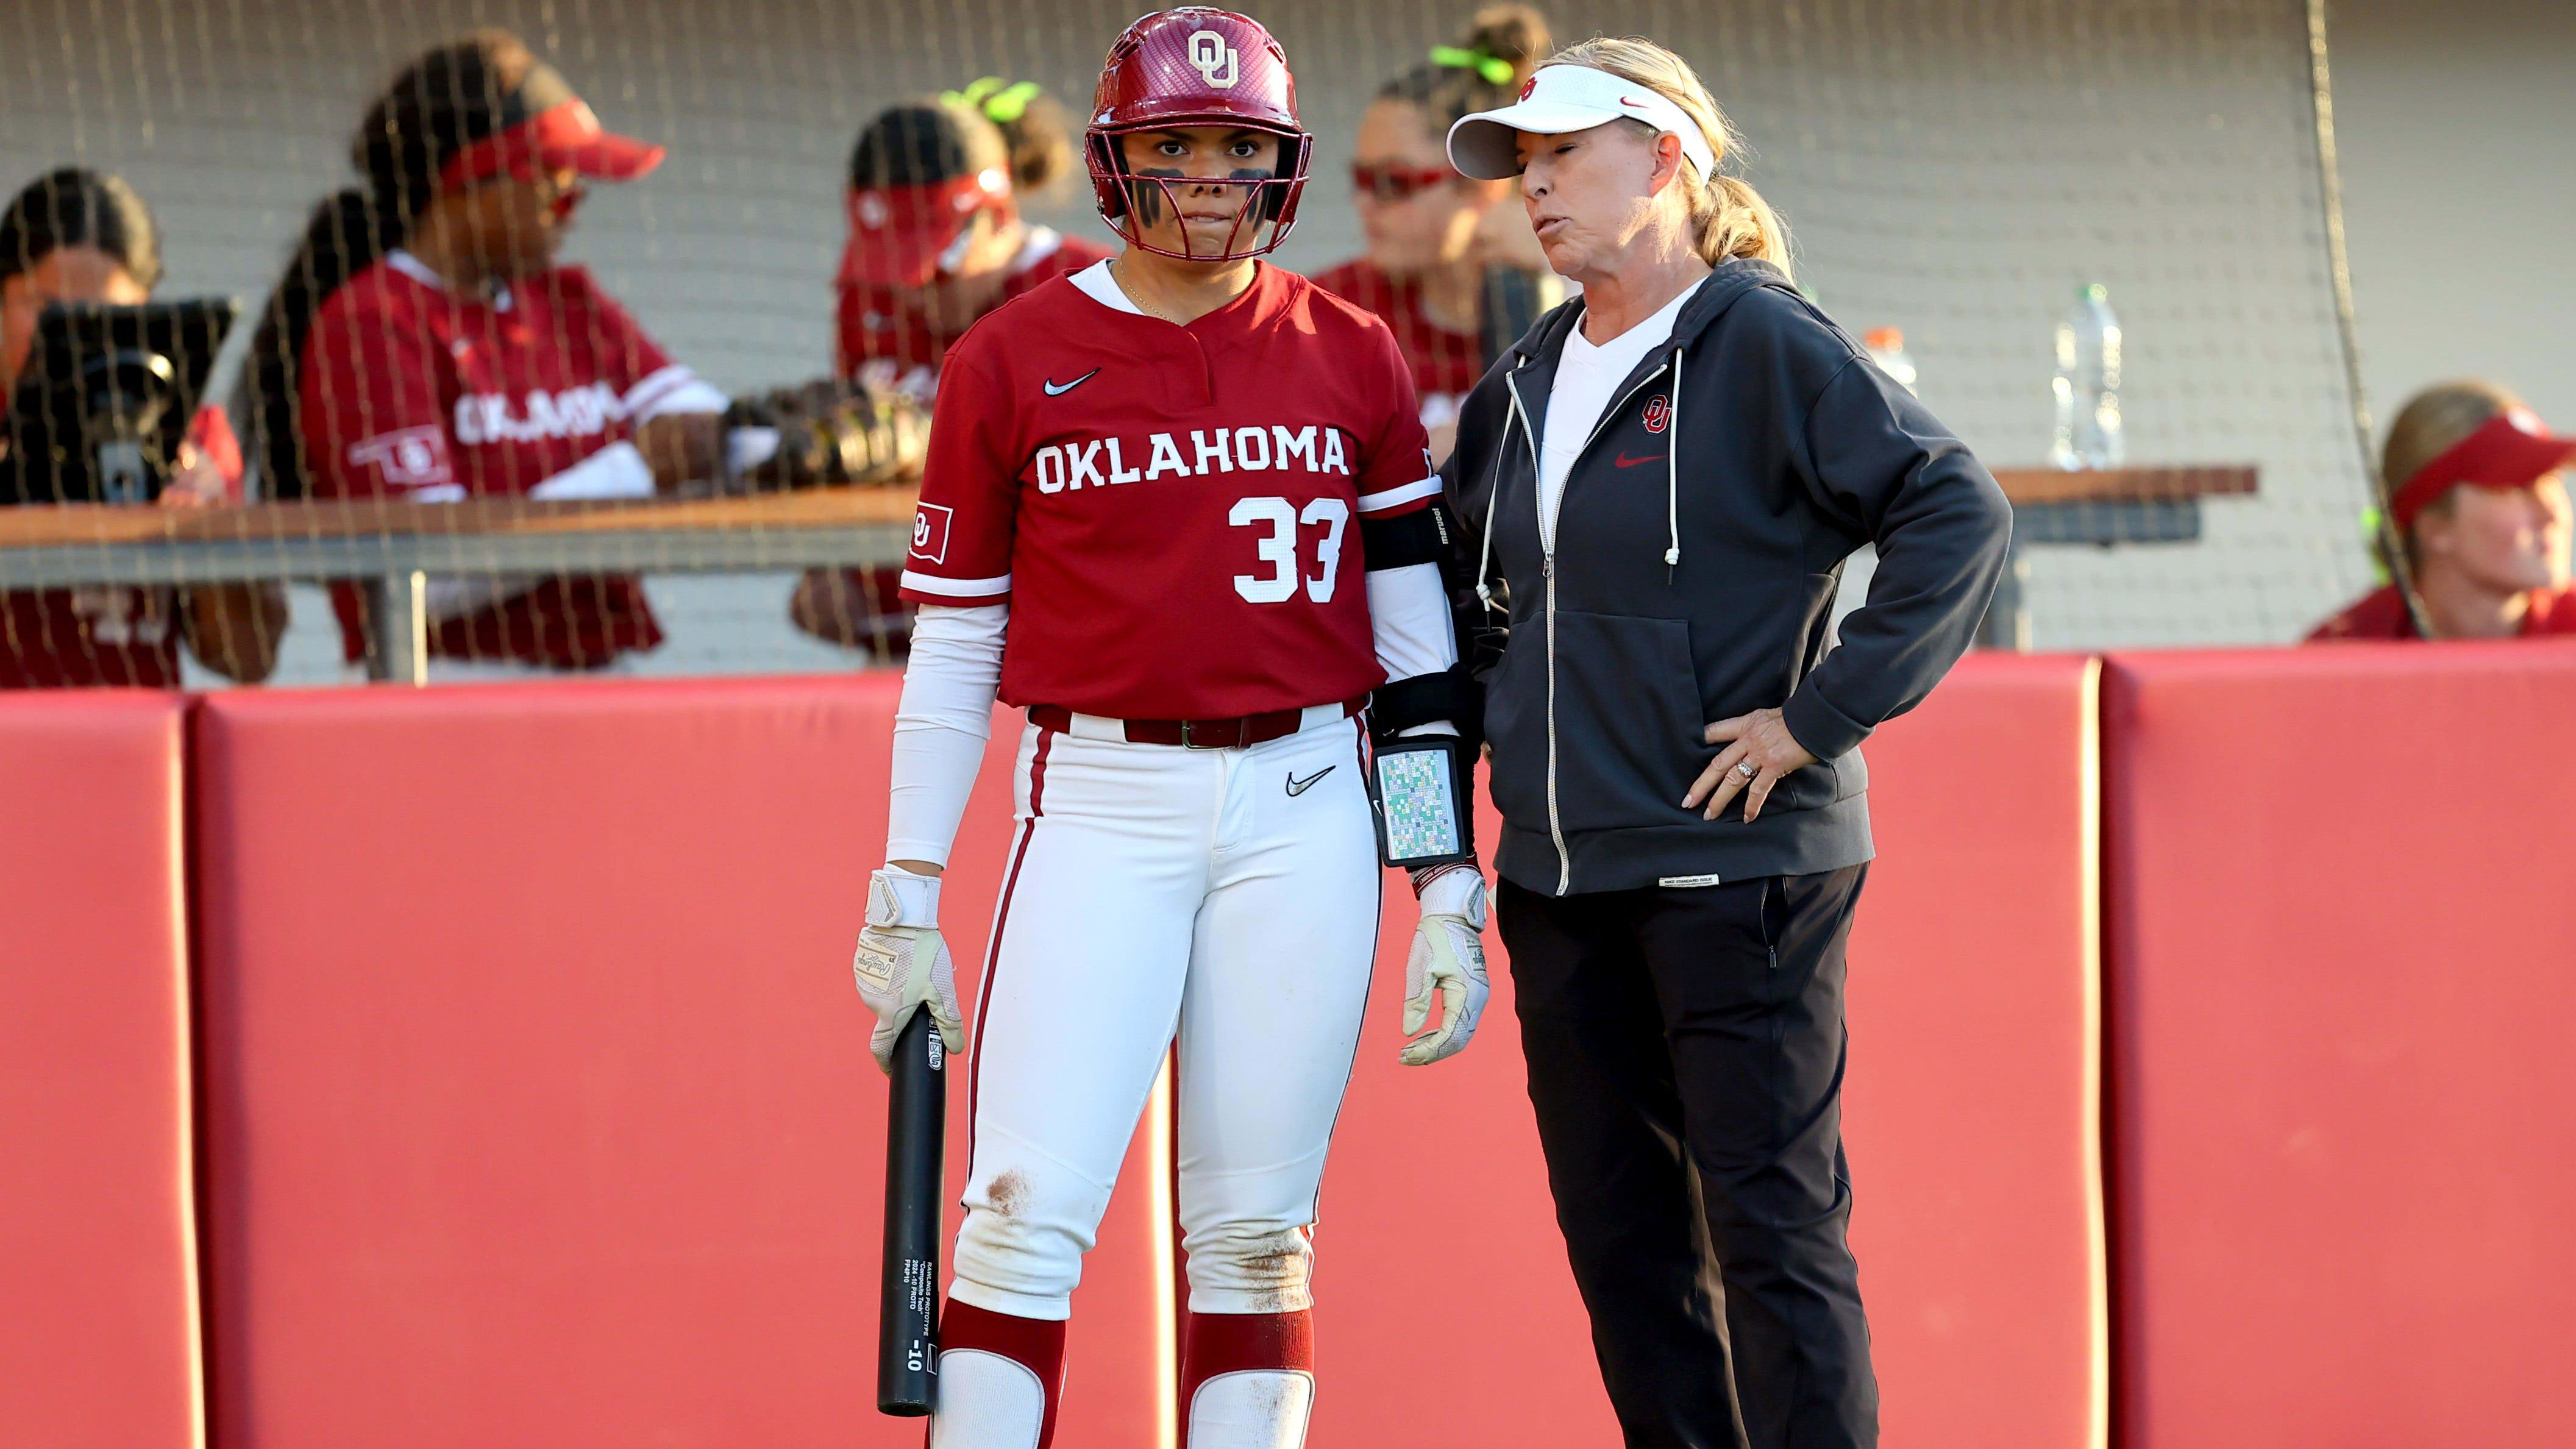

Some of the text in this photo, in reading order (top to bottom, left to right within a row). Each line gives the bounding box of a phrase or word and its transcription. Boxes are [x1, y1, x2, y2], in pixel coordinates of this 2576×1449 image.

[1187, 30, 1239, 89] OU
[1642, 394, 1672, 434] OU
[1036, 425, 1350, 494] OKLAHOMA
[914, 512, 931, 547] OU
[1229, 496, 1350, 603] 33
[858, 953, 891, 976] Rawlings
[908, 1339, 923, 1372] -10
